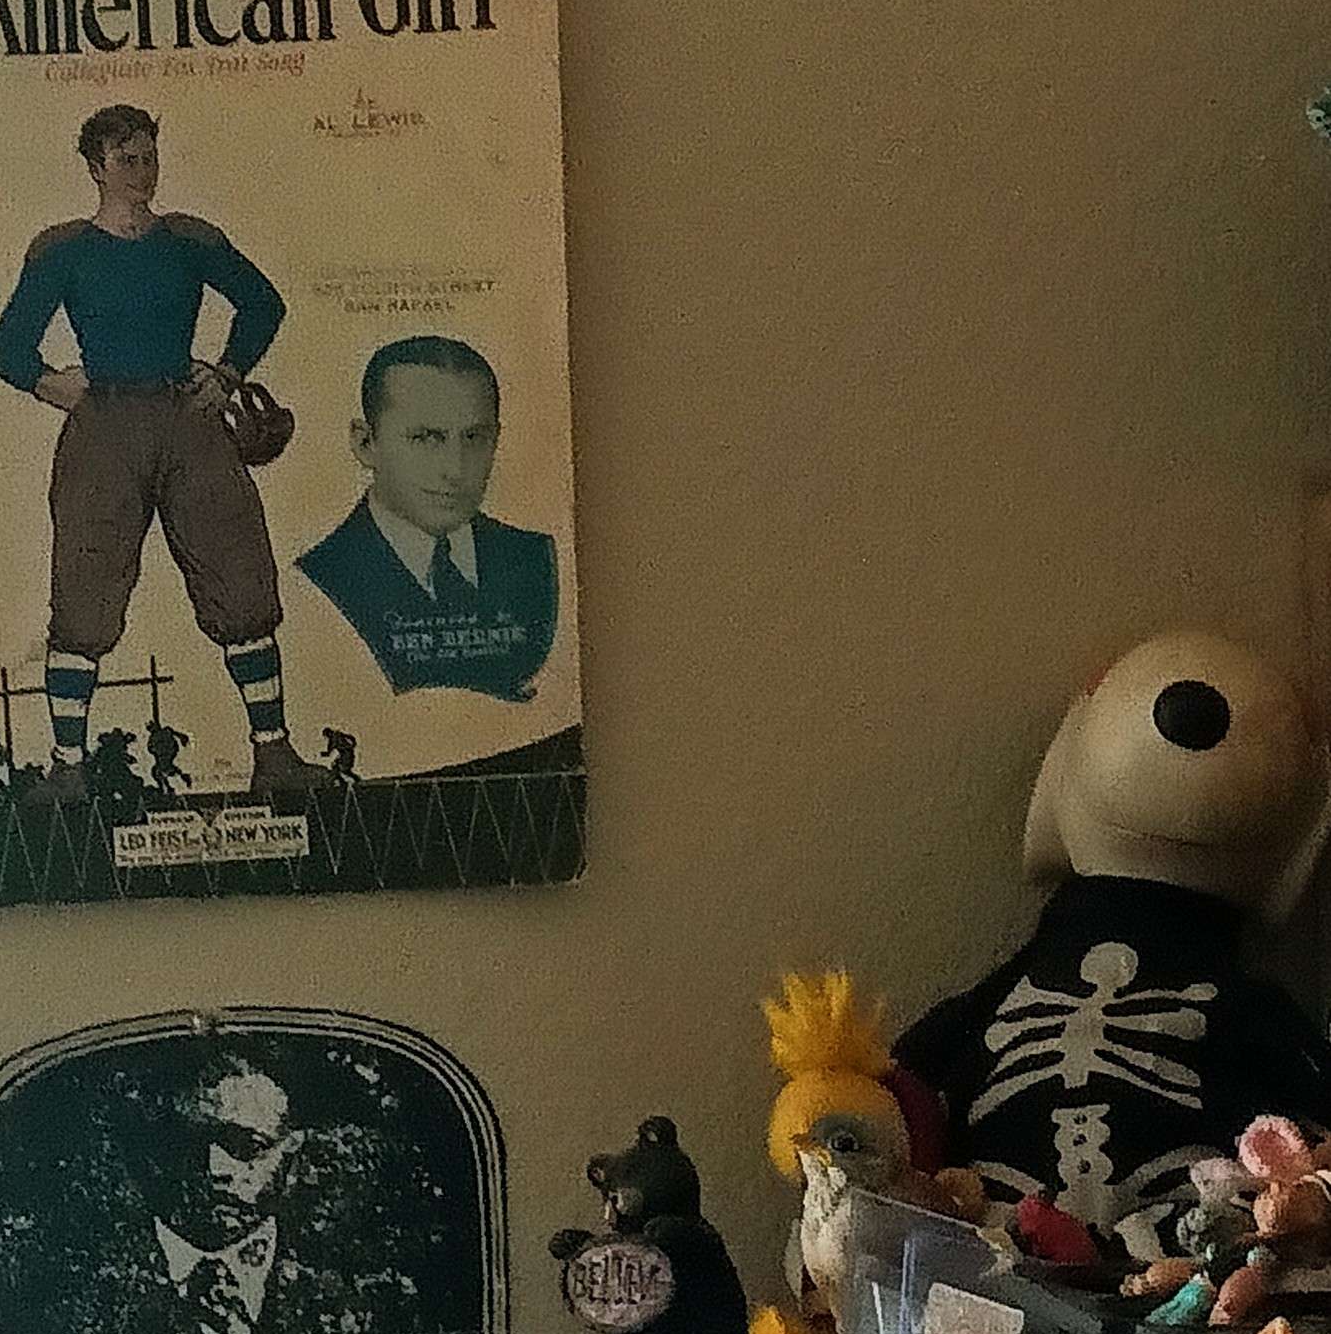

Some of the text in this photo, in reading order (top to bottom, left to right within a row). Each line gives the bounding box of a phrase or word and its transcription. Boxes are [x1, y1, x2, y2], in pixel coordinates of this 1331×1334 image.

[225, 824, 260, 844] NEW
[261, 821, 305, 841] YORK
[573, 1255, 665, 1307] BELIEVE
